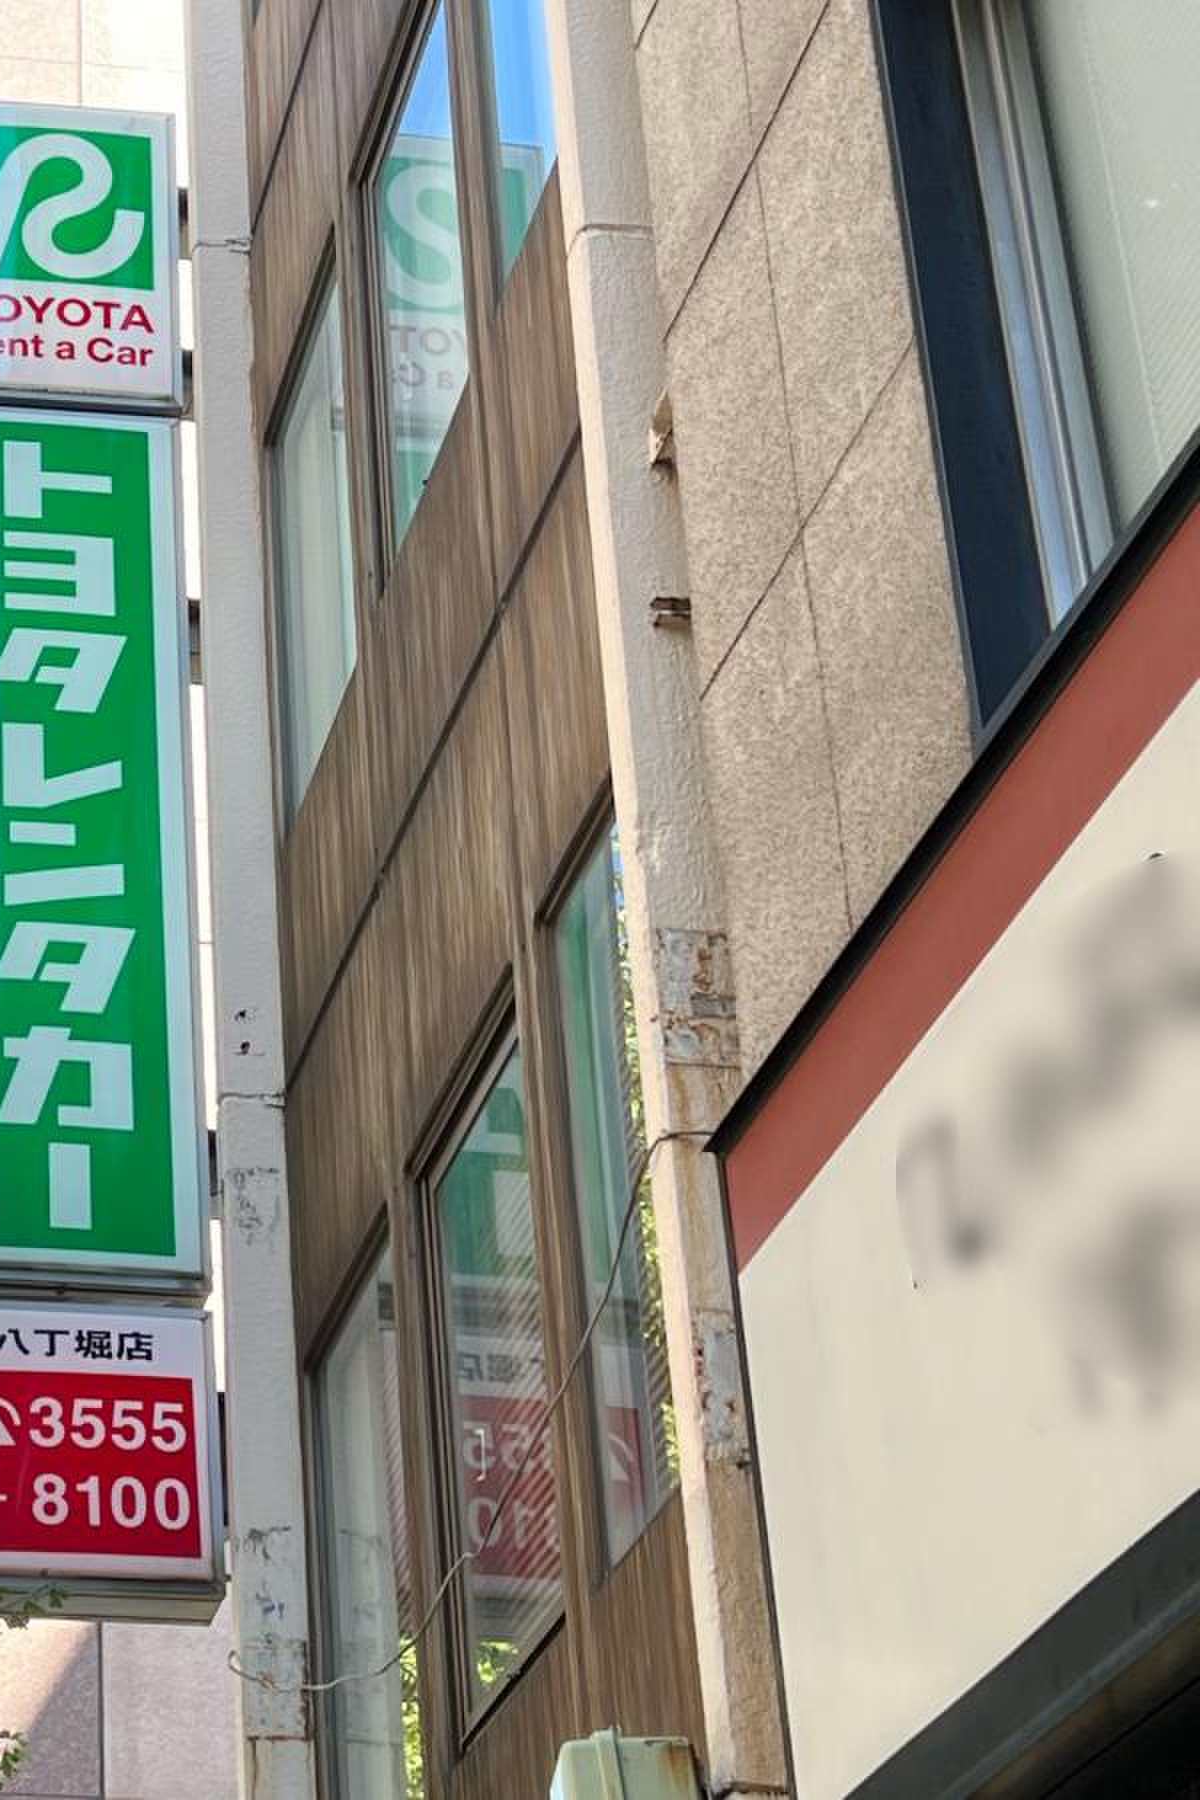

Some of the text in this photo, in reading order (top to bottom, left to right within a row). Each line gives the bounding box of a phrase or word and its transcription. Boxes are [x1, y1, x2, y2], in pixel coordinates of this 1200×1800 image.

[55, 341, 76, 360] a
[87, 337, 154, 367] Car
[29, 1396, 187, 1453] 3555
